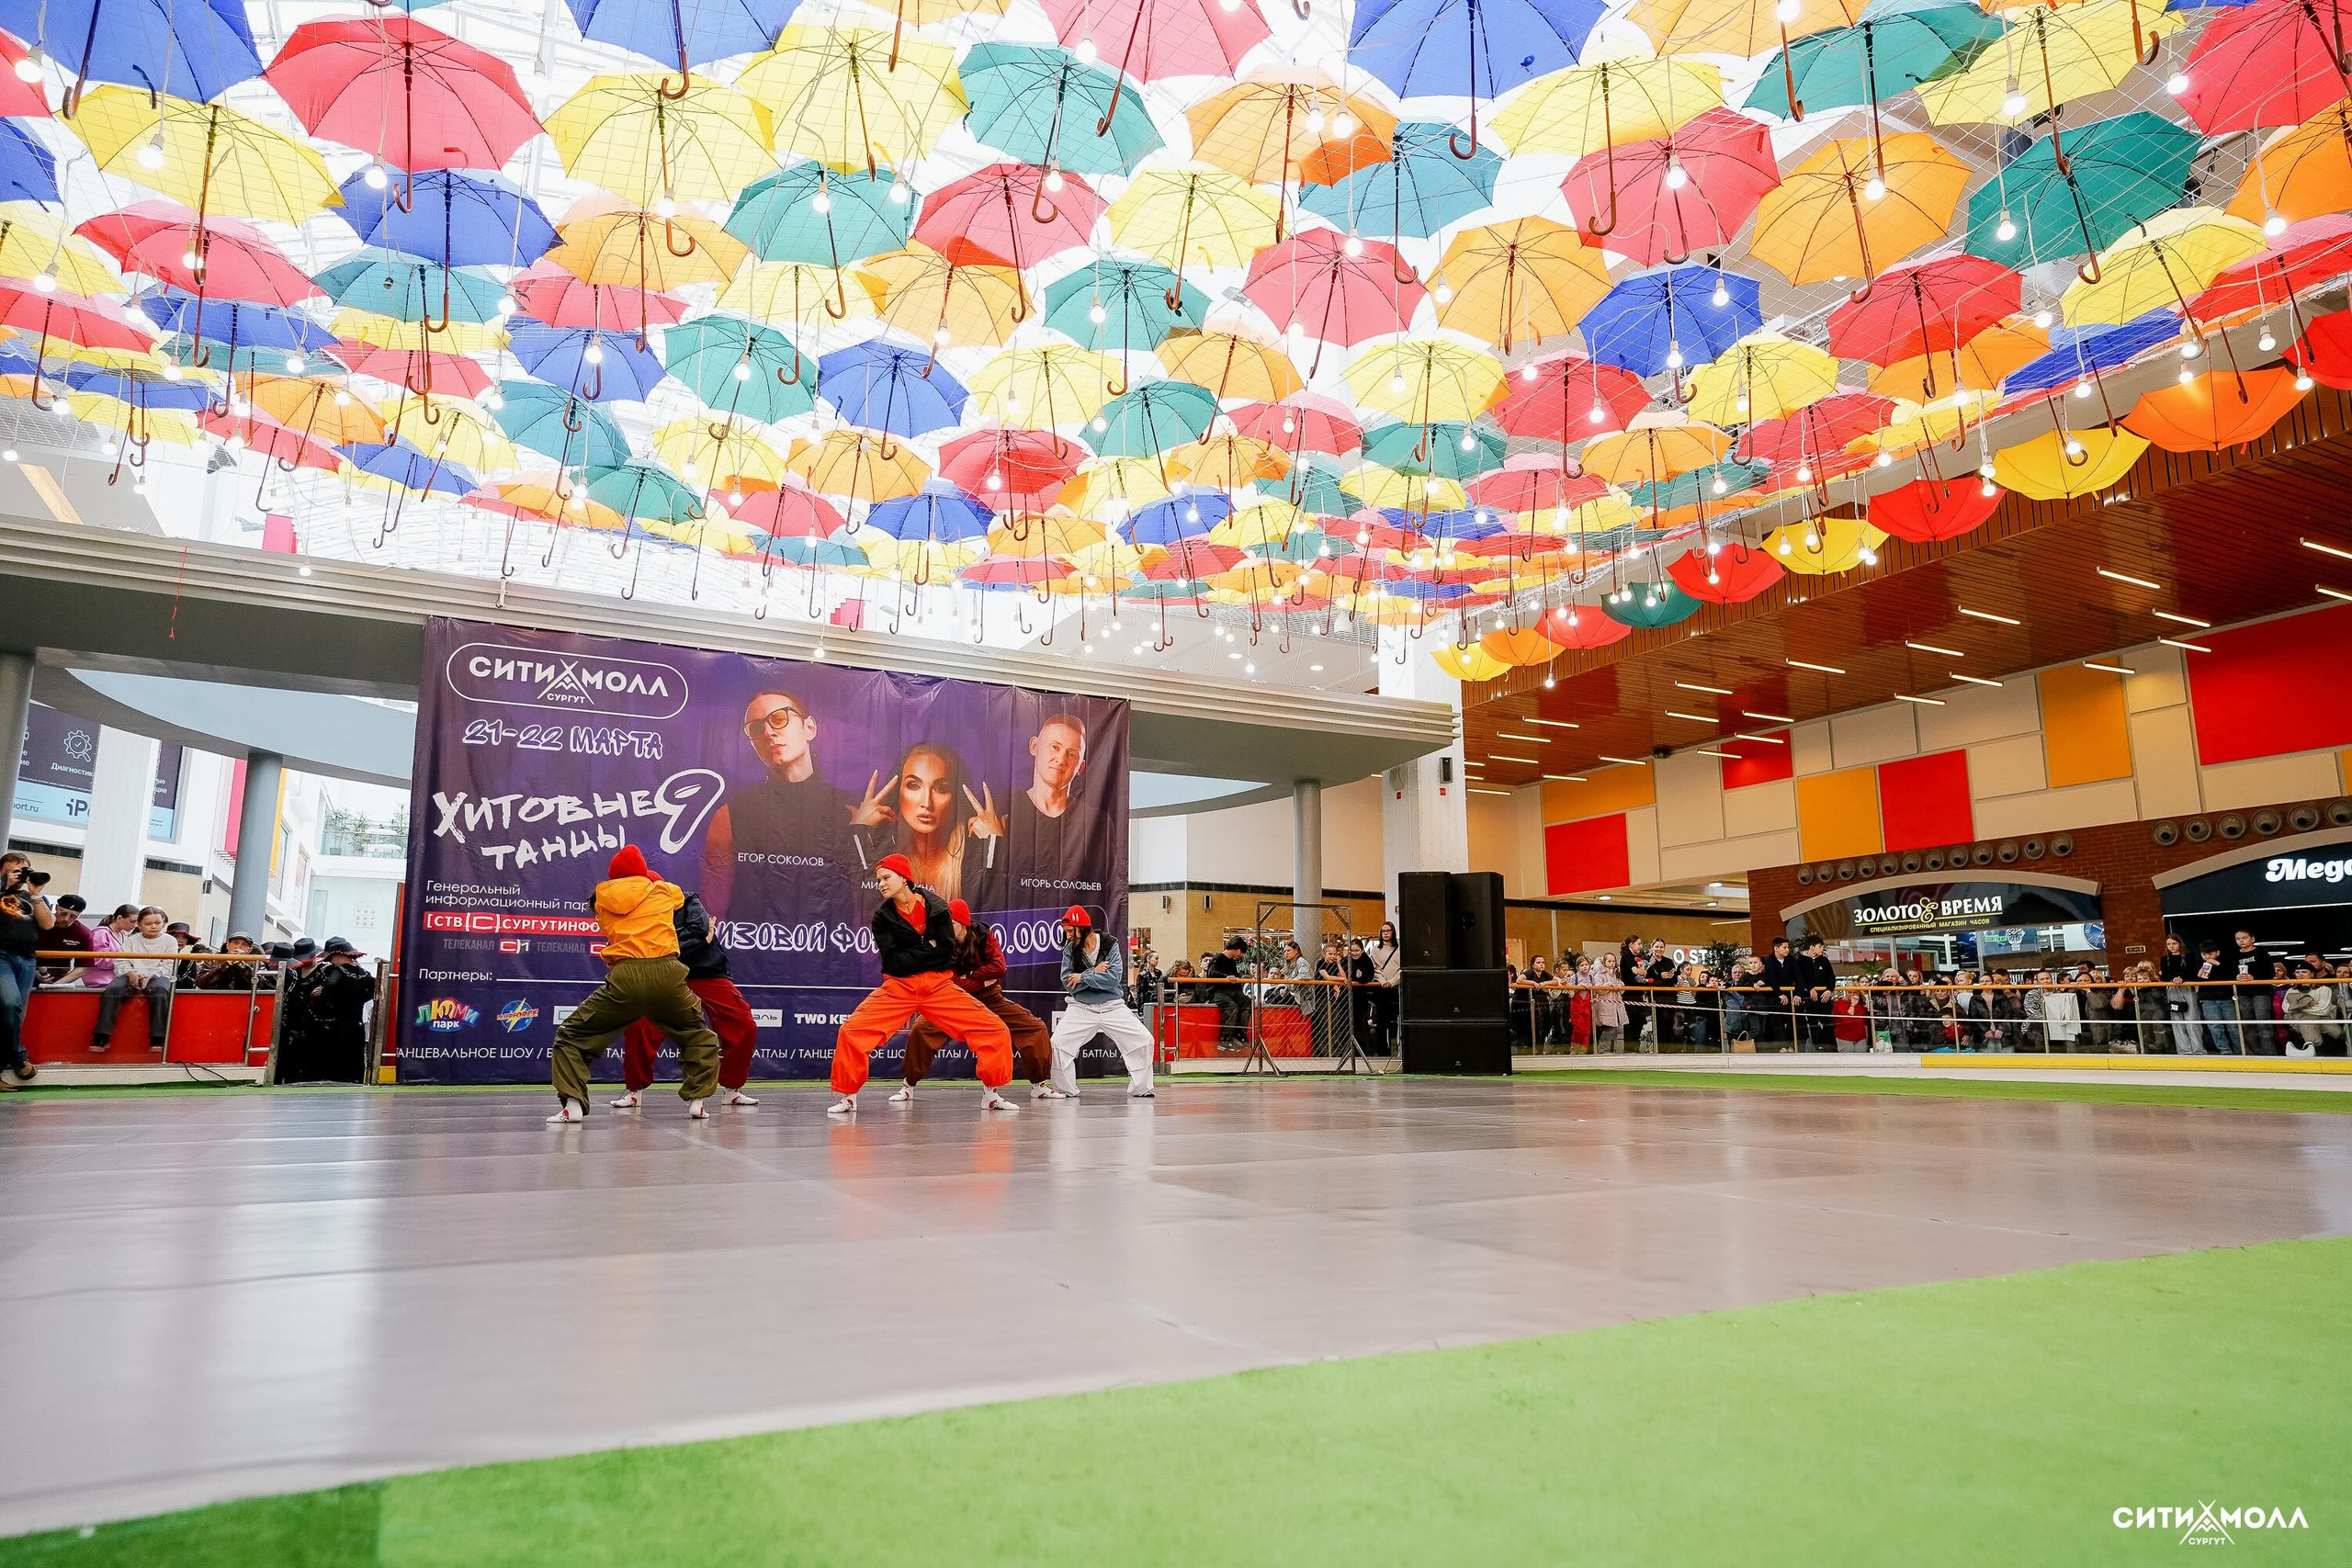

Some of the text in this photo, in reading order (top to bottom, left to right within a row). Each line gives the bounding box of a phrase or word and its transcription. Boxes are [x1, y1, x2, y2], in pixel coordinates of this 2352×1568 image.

[469, 657, 669, 697] СИТИ МОЛЛ
[547, 693, 586, 704] СУРГУТ
[462, 719, 663, 760] 21-22 МАРТА
[433, 790, 658, 843] ХИТОВЫЕ
[481, 824, 626, 870] ТАНЦЫ
[738, 852, 824, 866] ЕГОР СОКОЛОВ
[426, 880, 521, 896] Генеральный
[1021, 878, 1102, 891] ИГОРЬ СОЛОВЬЕВ
[425, 894, 591, 912] информационный пар
[1941, 896, 2003, 916] ВРЕМЯ
[502, 918, 601, 933] СУРГУТИНФО
[1870, 921, 1937, 933] СПЕЦИАЛИЗИРОВАННЫЙ
[1939, 919, 1967, 928] МАГАЗИН
[715, 920, 827, 953] ИЗОВОЙ
[443, 938, 494, 951] ТЕЛЕКАНАЛ
[537, 942, 585, 953] ТЕЛЕКАНАЛ
[419, 968, 493, 982] Партнеры:
[433, 1021, 460, 1030] парк
[794, 1013, 851, 1025] TWO KE
[500, 1048, 534, 1058] ШОУ
[752, 1048, 787, 1058] АТТЛЫ
[1082, 1049, 1117, 1058] БАТТЛЫ
